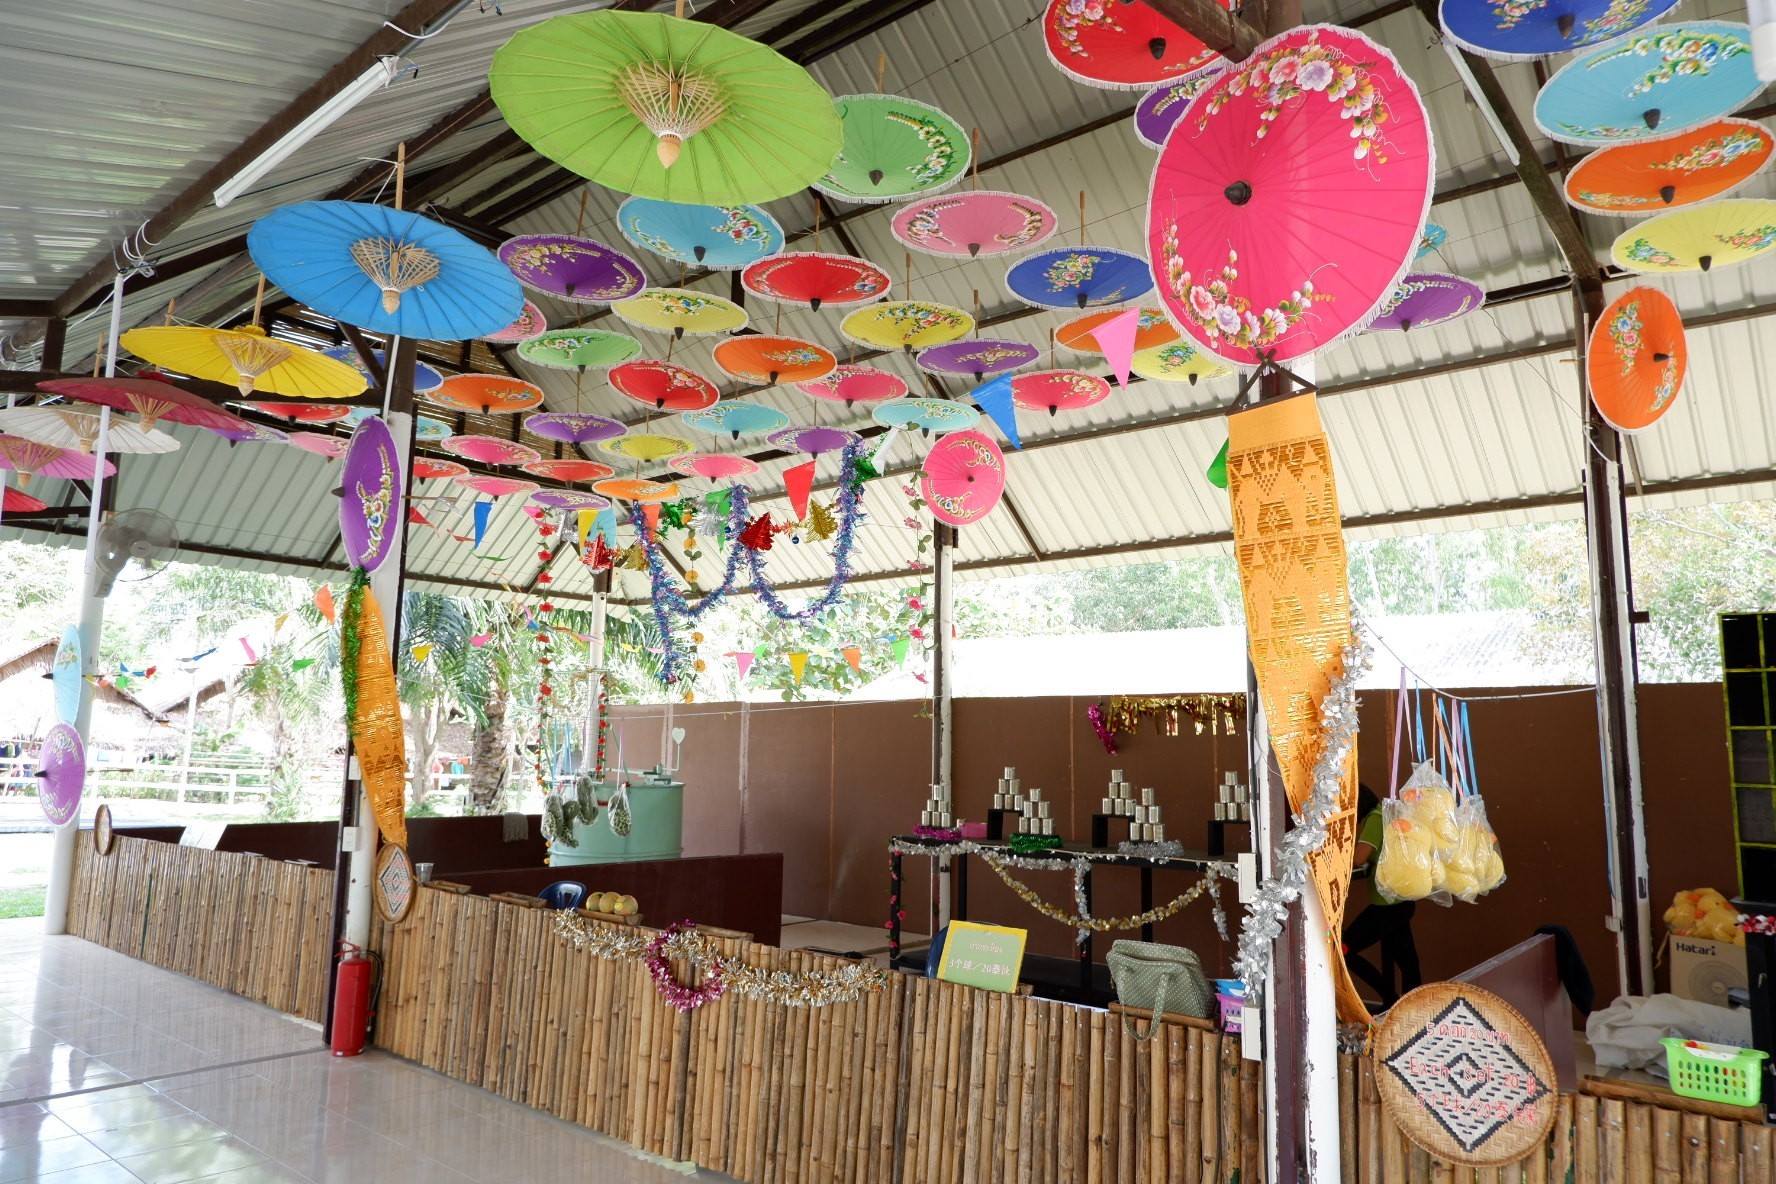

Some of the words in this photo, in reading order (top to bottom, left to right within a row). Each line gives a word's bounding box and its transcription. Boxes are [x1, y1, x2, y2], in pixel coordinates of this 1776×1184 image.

[1676, 942, 1716, 956] Hatari
[1426, 1022, 1435, 1036] 5
[1409, 1055, 1450, 1079] Each
[1463, 1061, 1494, 1082] set
